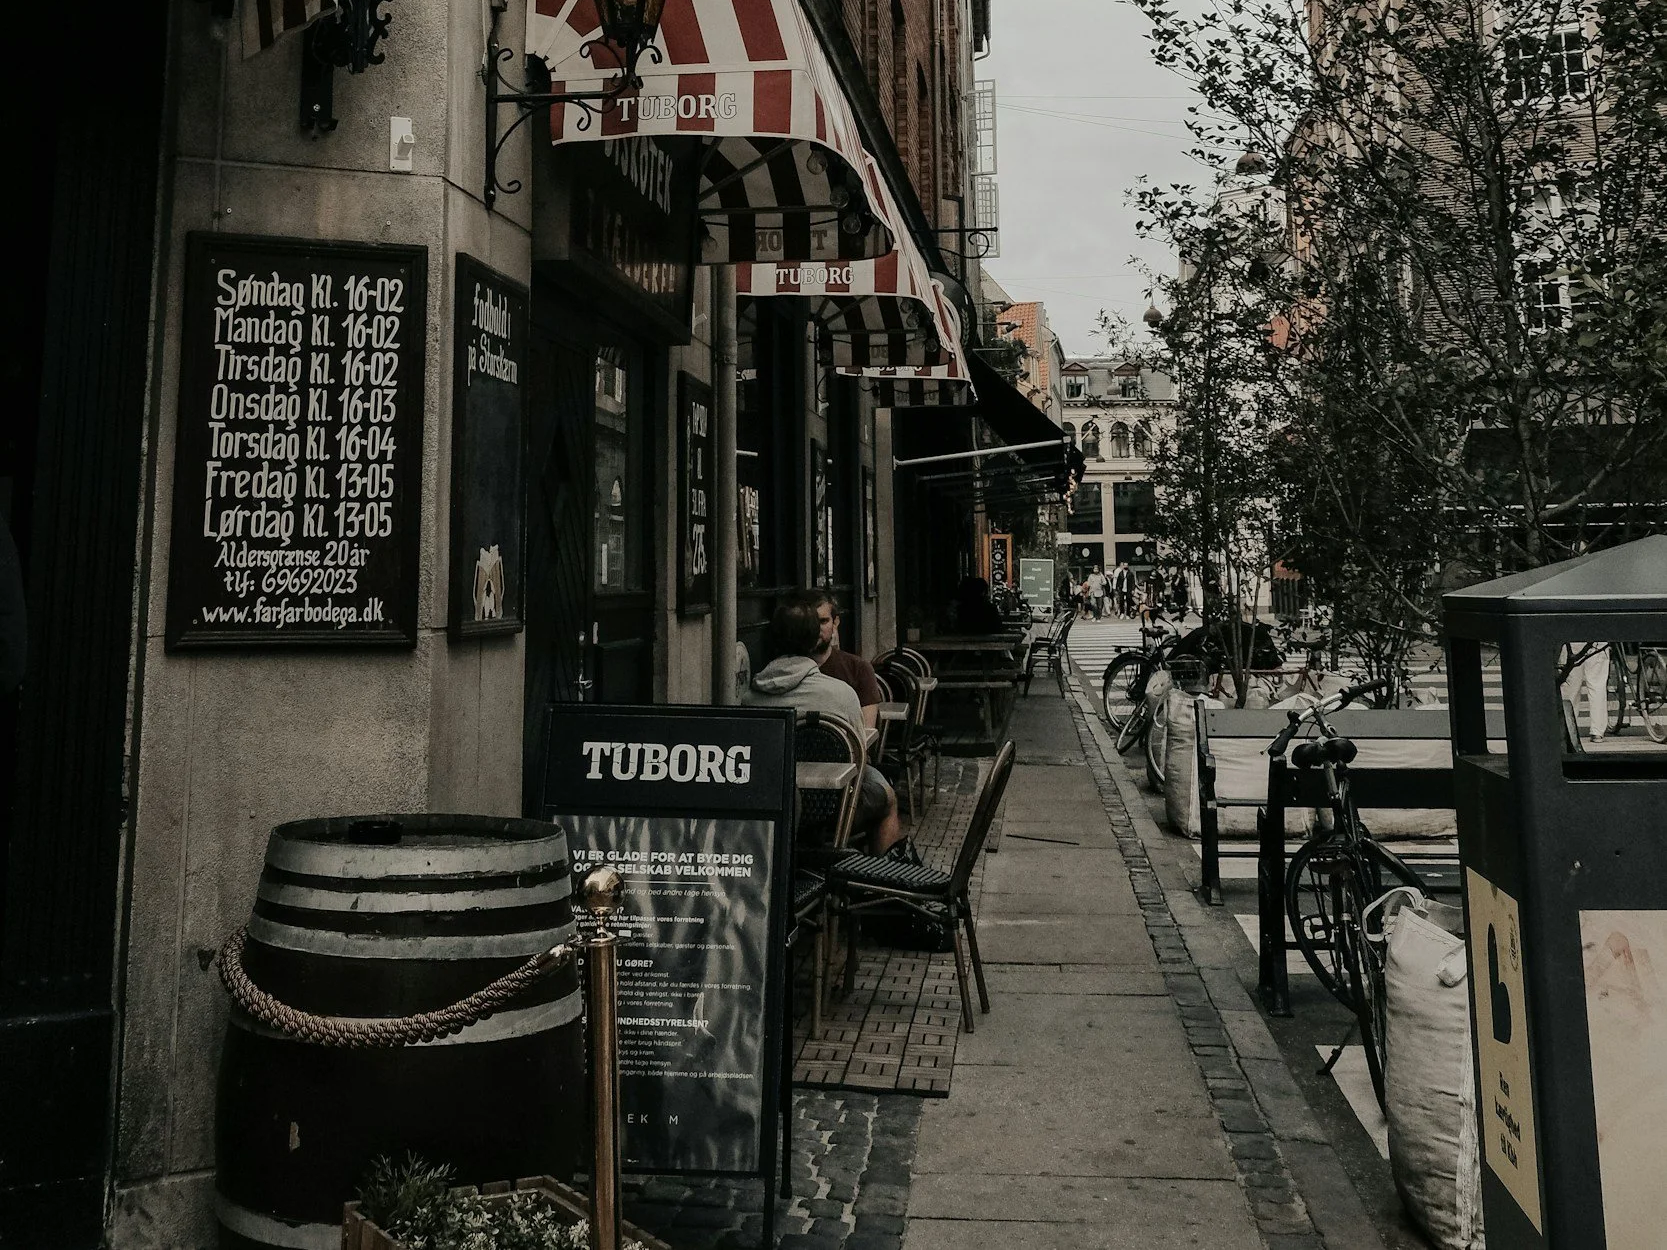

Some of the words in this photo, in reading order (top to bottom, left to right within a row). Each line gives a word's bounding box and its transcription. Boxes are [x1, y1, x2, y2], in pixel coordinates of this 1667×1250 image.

[616, 93, 737, 121] TUBORG
[217, 269, 305, 314] Søndag
[311, 274, 338, 309] Kl.
[344, 275, 404, 312] 16-02
[776, 267, 854, 285] TUBORG
[214, 307, 302, 352] Mandag
[311, 311, 335, 347] Kl.
[341, 314, 401, 349] 16-02
[215, 345, 301, 391] Tirsdag
[310, 350, 335, 384] Kl.
[341, 351, 399, 386] 16-02
[210, 384, 300, 429] Onsdag
[307, 388, 333, 421] Kl.
[338, 388, 397, 423] 16-03
[208, 421, 299, 468] Torsdag
[305, 425, 330, 461] Kl.
[335, 425, 397, 461] 16-04
[205, 461, 297, 508] Fredag
[335, 463, 394, 499] 13-05
[203, 498, 295, 545] Lørdag
[333, 502, 393, 538] 13-05
[214, 542, 320, 573] Aldersgrænse
[223, 569, 255, 598] tlf:
[261, 569, 358, 595] 69692023
[202, 596, 385, 630] www.farfarbodega.dk
[582, 741, 751, 784] TUBORG
[572, 850, 586, 860] VI
[588, 850, 604, 861] ER
[607, 851, 648, 862] GLADE
[650, 852, 676, 863] FOR
[678, 853, 694, 863] AT
[697, 853, 729, 864] BYDE
[732, 854, 754, 865] DIG
[617, 864, 672, 875] SELSKAB
[675, 865, 751, 877] VELKOMMEN
[625, 959, 654, 968] GØRE?
